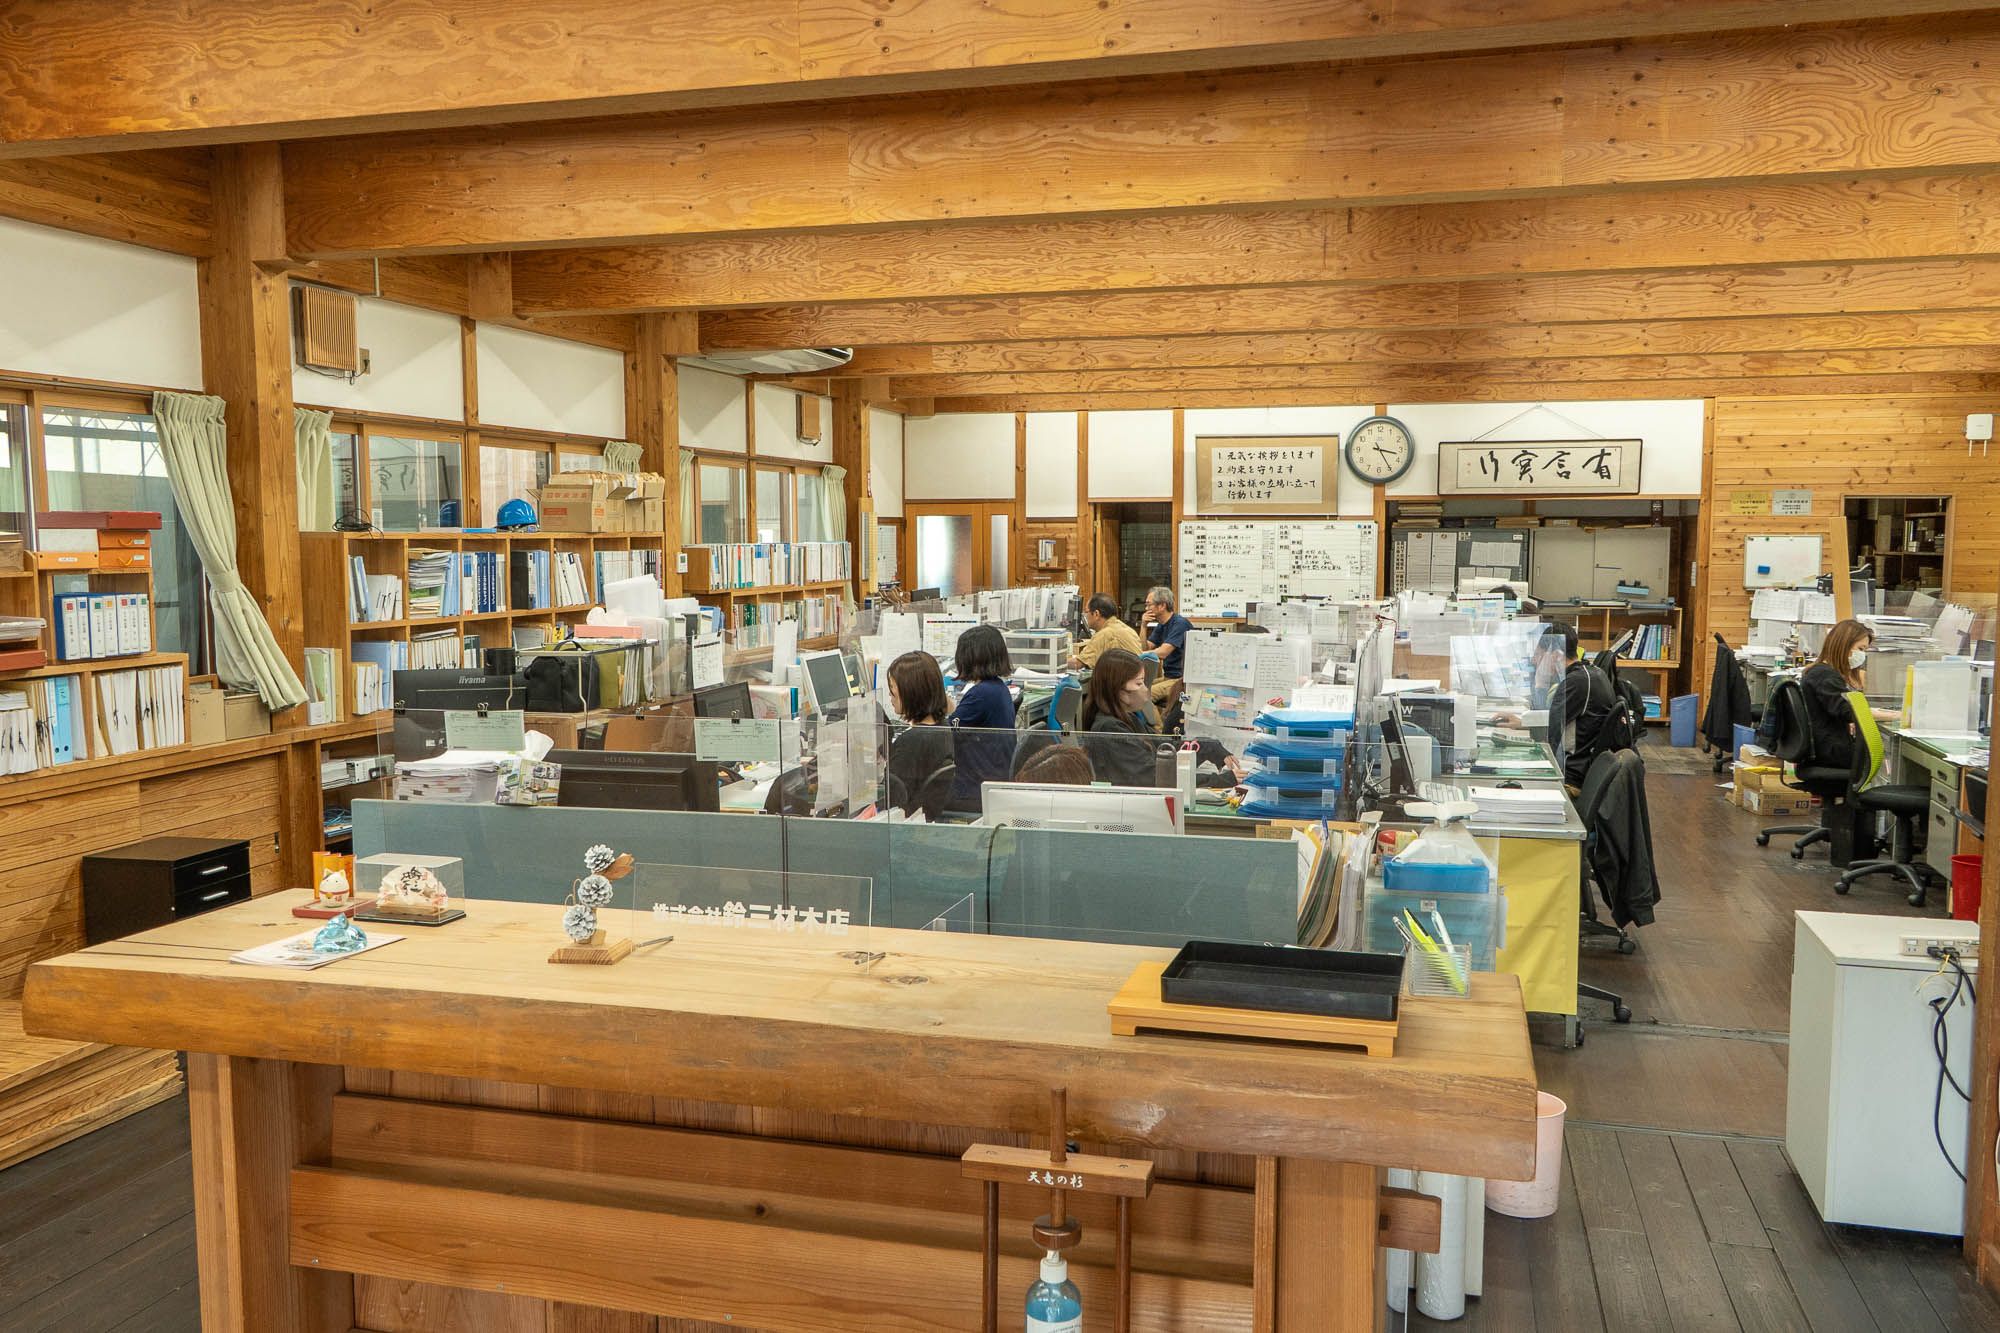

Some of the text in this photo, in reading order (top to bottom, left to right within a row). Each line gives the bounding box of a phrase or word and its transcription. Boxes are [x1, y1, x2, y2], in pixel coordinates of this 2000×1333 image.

[458, 676, 486, 684] iiyama
[1028, 1170, 1083, 1188] 天竜の杉
